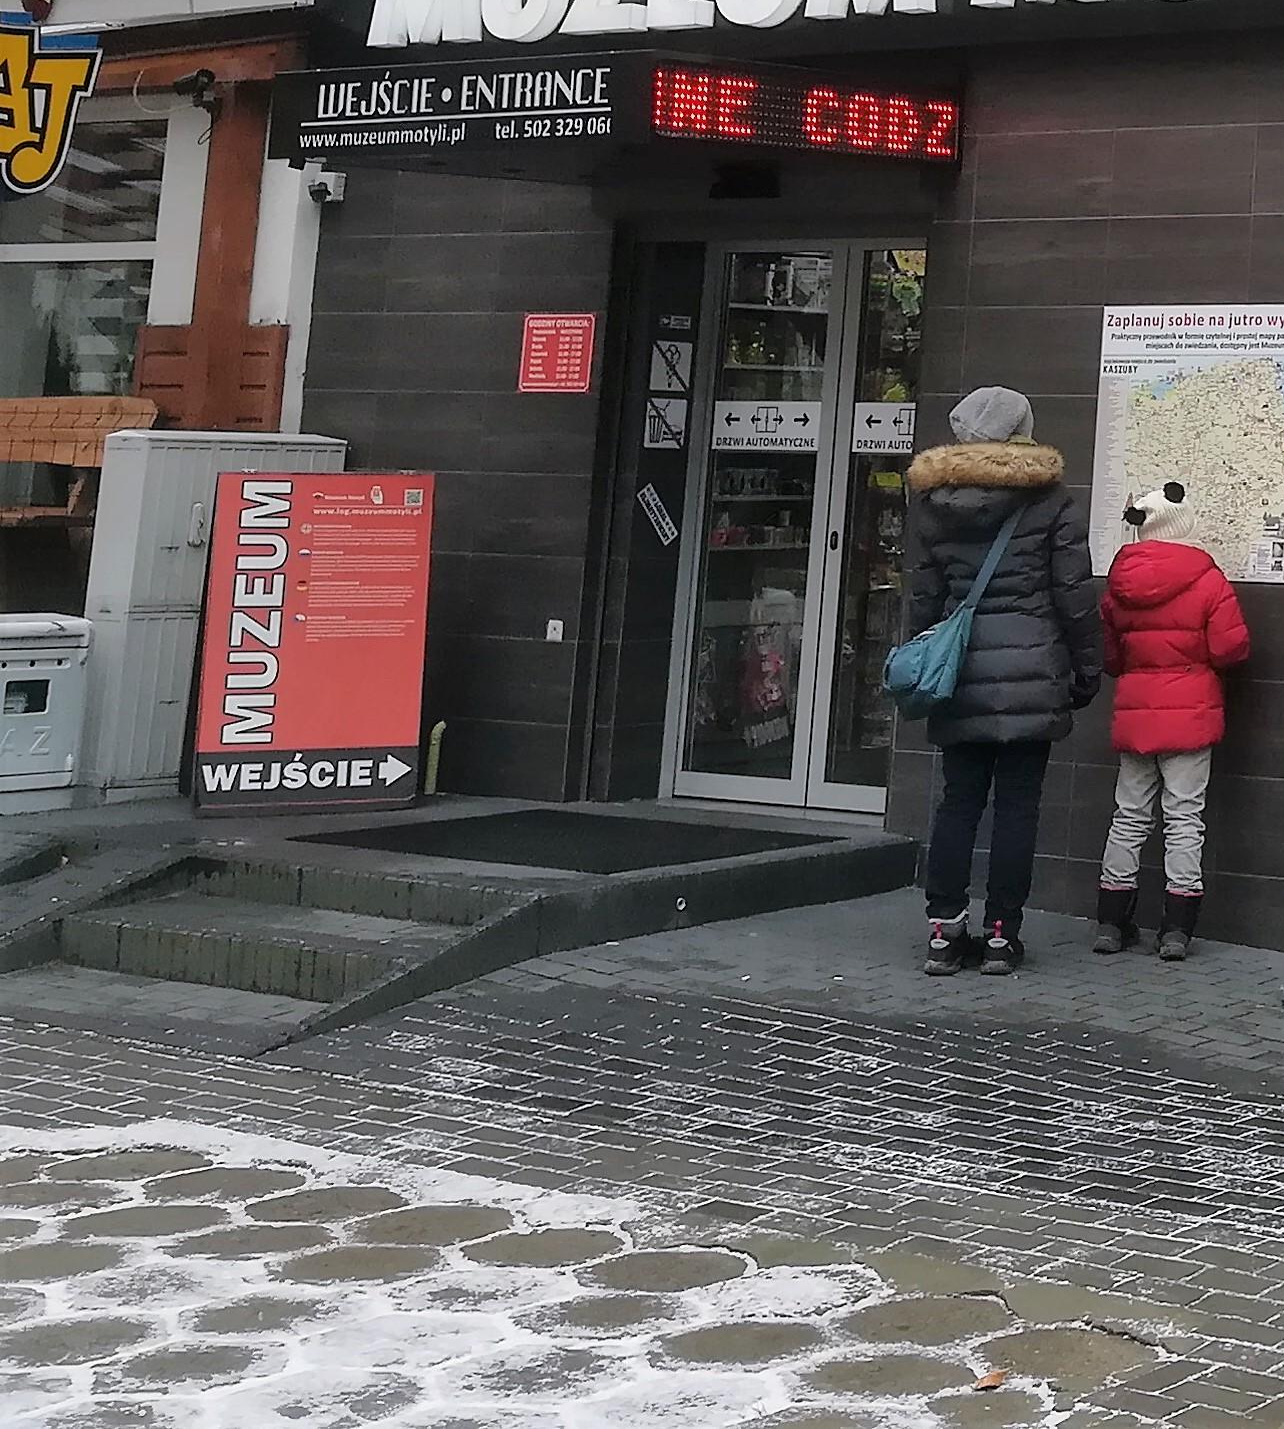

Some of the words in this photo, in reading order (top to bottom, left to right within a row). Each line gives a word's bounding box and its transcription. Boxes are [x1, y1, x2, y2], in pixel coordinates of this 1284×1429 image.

[317, 70, 437, 118] WEJŚCIE
[460, 67, 611, 111] ENTRANCE
[299, 122, 466, 148] www.muzeummotyli.pl
[495, 120, 519, 140] tel.
[523, 119, 551, 138] 502
[555, 118, 583, 136] 329
[1107, 313, 1164, 330] Zaplanuj
[1168, 313, 1205, 327] sobie
[1209, 315, 1225, 326] na
[1228, 313, 1263, 329] jutro
[1102, 365, 1138, 374] KASZUBY
[715, 437, 744, 447] DRZWI
[745, 437, 815, 448] AUTOMATYCZNE
[856, 439, 886, 450] DRZWI
[220, 479, 293, 746] MUZEUM
[201, 752, 375, 793] WEJŚCIE
